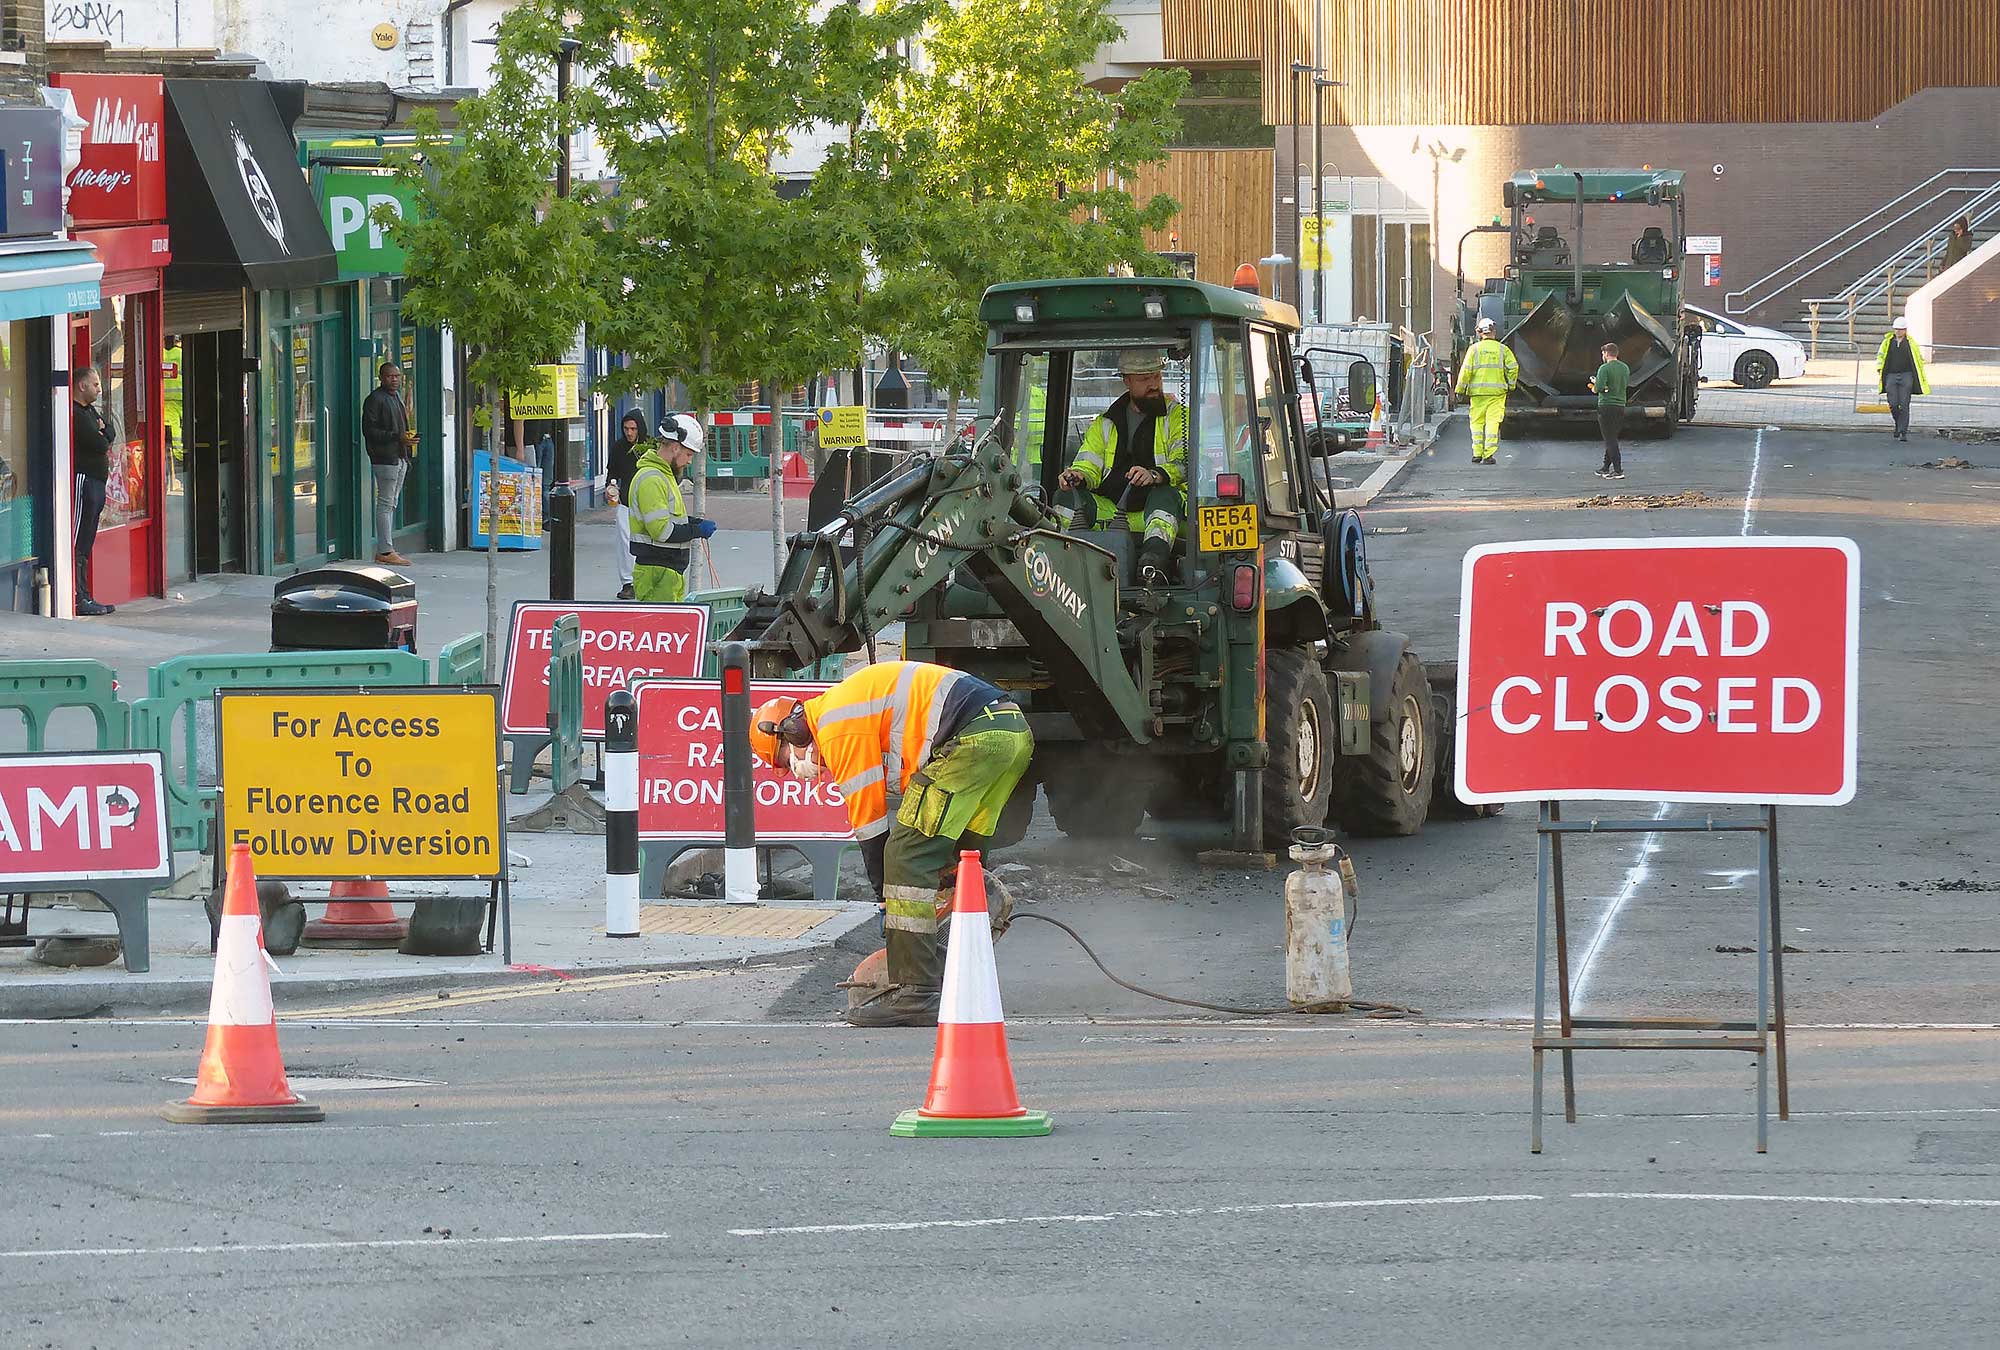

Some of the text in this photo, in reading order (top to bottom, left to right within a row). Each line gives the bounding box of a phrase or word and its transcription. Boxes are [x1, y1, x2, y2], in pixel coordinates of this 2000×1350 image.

[71, 168, 131, 192] Mickey's
[514, 405, 554, 416] WARNING
[823, 435, 862, 445] WARNING
[1203, 506, 1252, 527] RE64
[1024, 547, 1088, 620] CONWAY
[527, 629, 690, 654] TEPORARY
[1544, 600, 1770, 657] ROAD
[541, 664, 665, 688] SRFA
[1490, 675, 1822, 734] CLOSED
[272, 711, 440, 738] For Access
[335, 750, 372, 778] To
[247, 786, 469, 814] Florence Road
[643, 778, 844, 807] IRONORKS
[233, 829, 490, 855] Follow Diversion
